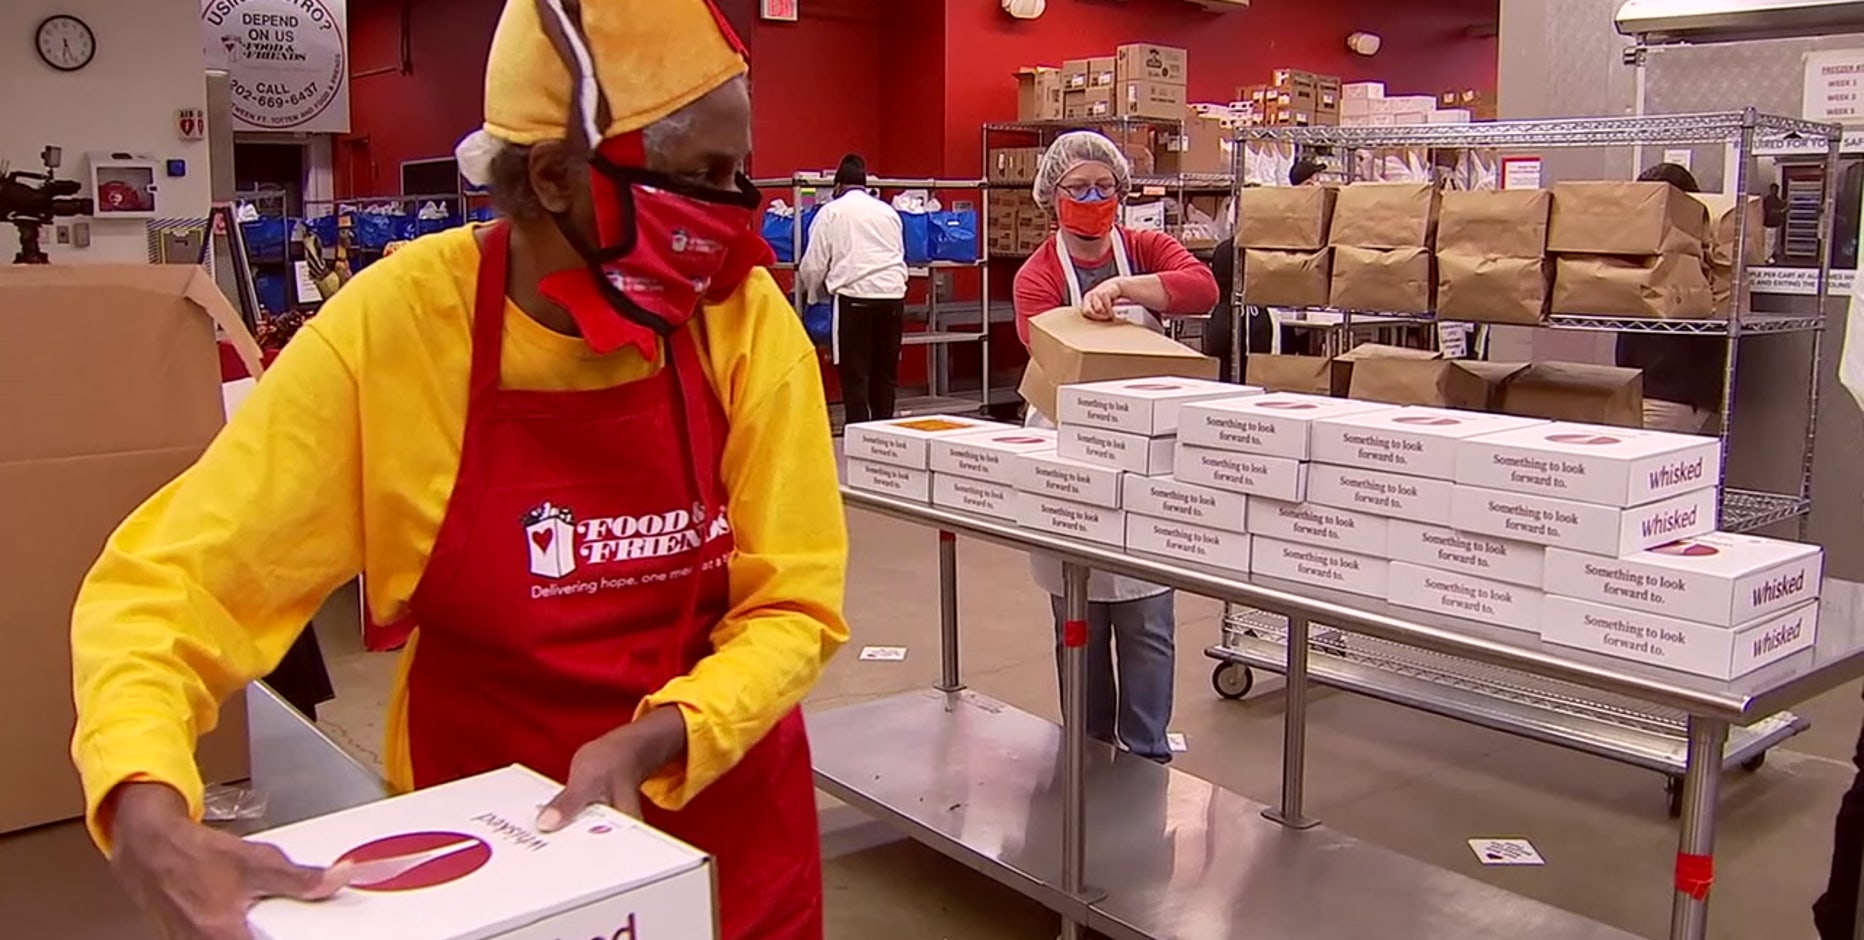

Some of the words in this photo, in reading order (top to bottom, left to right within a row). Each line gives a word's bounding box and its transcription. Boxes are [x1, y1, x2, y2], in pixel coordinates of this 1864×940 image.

[242, 13, 299, 28] DEPEND
[248, 29, 269, 41] ON
[275, 30, 294, 43] US
[256, 82, 290, 95] CALL
[1786, 138, 1807, 148] FOR
[1343, 433, 1390, 448] Something
[1391, 439, 1401, 449] to
[1402, 439, 1424, 451] look
[1358, 448, 1394, 462] forward
[1395, 454, 1408, 464] to.
[1493, 454, 1547, 470] Something
[1548, 461, 1560, 471] to
[1561, 462, 1585, 474] look
[1340, 476, 1386, 492] Something
[1387, 482, 1396, 493] to
[1397, 484, 1418, 496] look
[1511, 471, 1552, 486] forward
[1553, 477, 1568, 488] to.
[1151, 487, 1189, 501] Something
[1198, 495, 1216, 506] look
[1355, 492, 1389, 506] forward
[1390, 497, 1402, 508] to.
[1163, 502, 1192, 514] forward
[1278, 506, 1324, 522] Something
[1324, 515, 1334, 524] to
[1335, 516, 1355, 527] look
[1488, 501, 1541, 519] Something
[1542, 510, 1554, 520] to
[1554, 511, 1580, 524] look
[577, 510, 689, 541] FOOD
[1154, 525, 1192, 540] Something
[1202, 534, 1219, 544] look
[1292, 522, 1327, 536] forward
[1328, 529, 1340, 538] to.
[1506, 518, 1545, 534] forward
[1546, 526, 1560, 537] to.
[1166, 540, 1196, 552] forward
[1422, 532, 1472, 549] Something
[1473, 541, 1484, 551] to
[1484, 543, 1508, 555] look
[1284, 548, 1328, 564] Something
[1329, 556, 1338, 566] to
[1339, 558, 1360, 570] look
[1438, 549, 1476, 564] forward
[1477, 557, 1490, 567] to.
[1298, 564, 1331, 578] forward
[1332, 570, 1345, 580] to.
[1585, 564, 1644, 583] Something
[1645, 574, 1658, 586] to
[1658, 576, 1686, 590] look
[531, 581, 598, 599] Delivering
[600, 573, 638, 590] hope,
[642, 572, 667, 583] one
[1424, 578, 1476, 596] Something
[1477, 588, 1488, 598] to
[1489, 590, 1514, 603] look
[1604, 582, 1649, 600] forward
[1650, 590, 1666, 603] to.
[1442, 595, 1480, 610] forward
[1481, 603, 1496, 613] to.
[1584, 615, 1644, 635] Something
[1645, 627, 1658, 638] to
[1659, 629, 1686, 644] look
[1604, 634, 1648, 652] forward
[1650, 643, 1666, 656] to.
